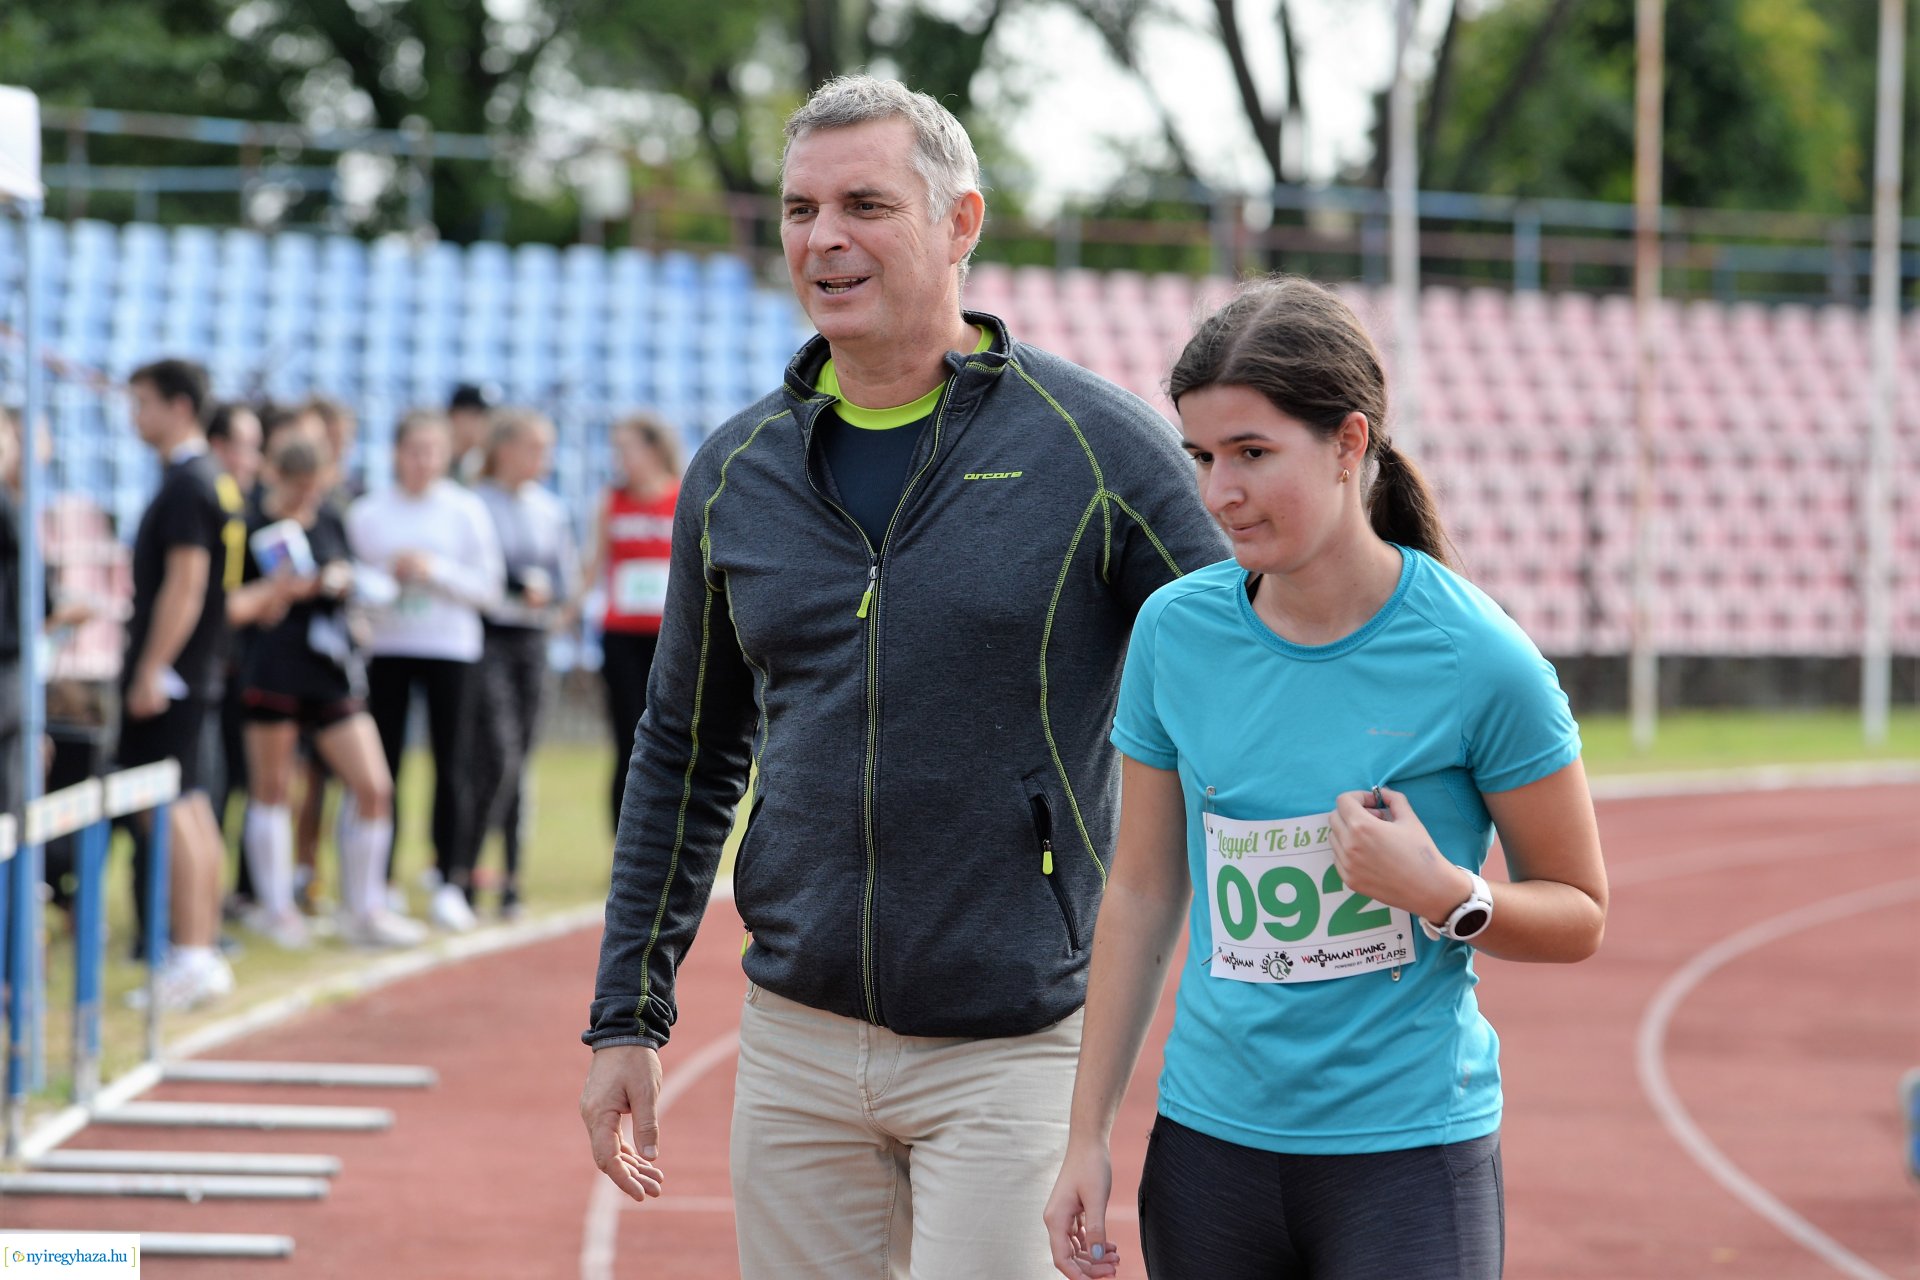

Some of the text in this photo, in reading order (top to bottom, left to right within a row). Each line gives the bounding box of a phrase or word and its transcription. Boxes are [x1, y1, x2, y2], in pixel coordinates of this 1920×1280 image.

[1217, 829, 1259, 860] Legyél
[1264, 828, 1288, 852] Te
[1293, 826, 1311, 848] is
[1216, 864, 1392, 942] 092
[1221, 953, 1254, 969] WATCHMAN
[1301, 943, 1386, 967] WATCHMAN TIMING
[1366, 948, 1407, 964] MYLAPS
